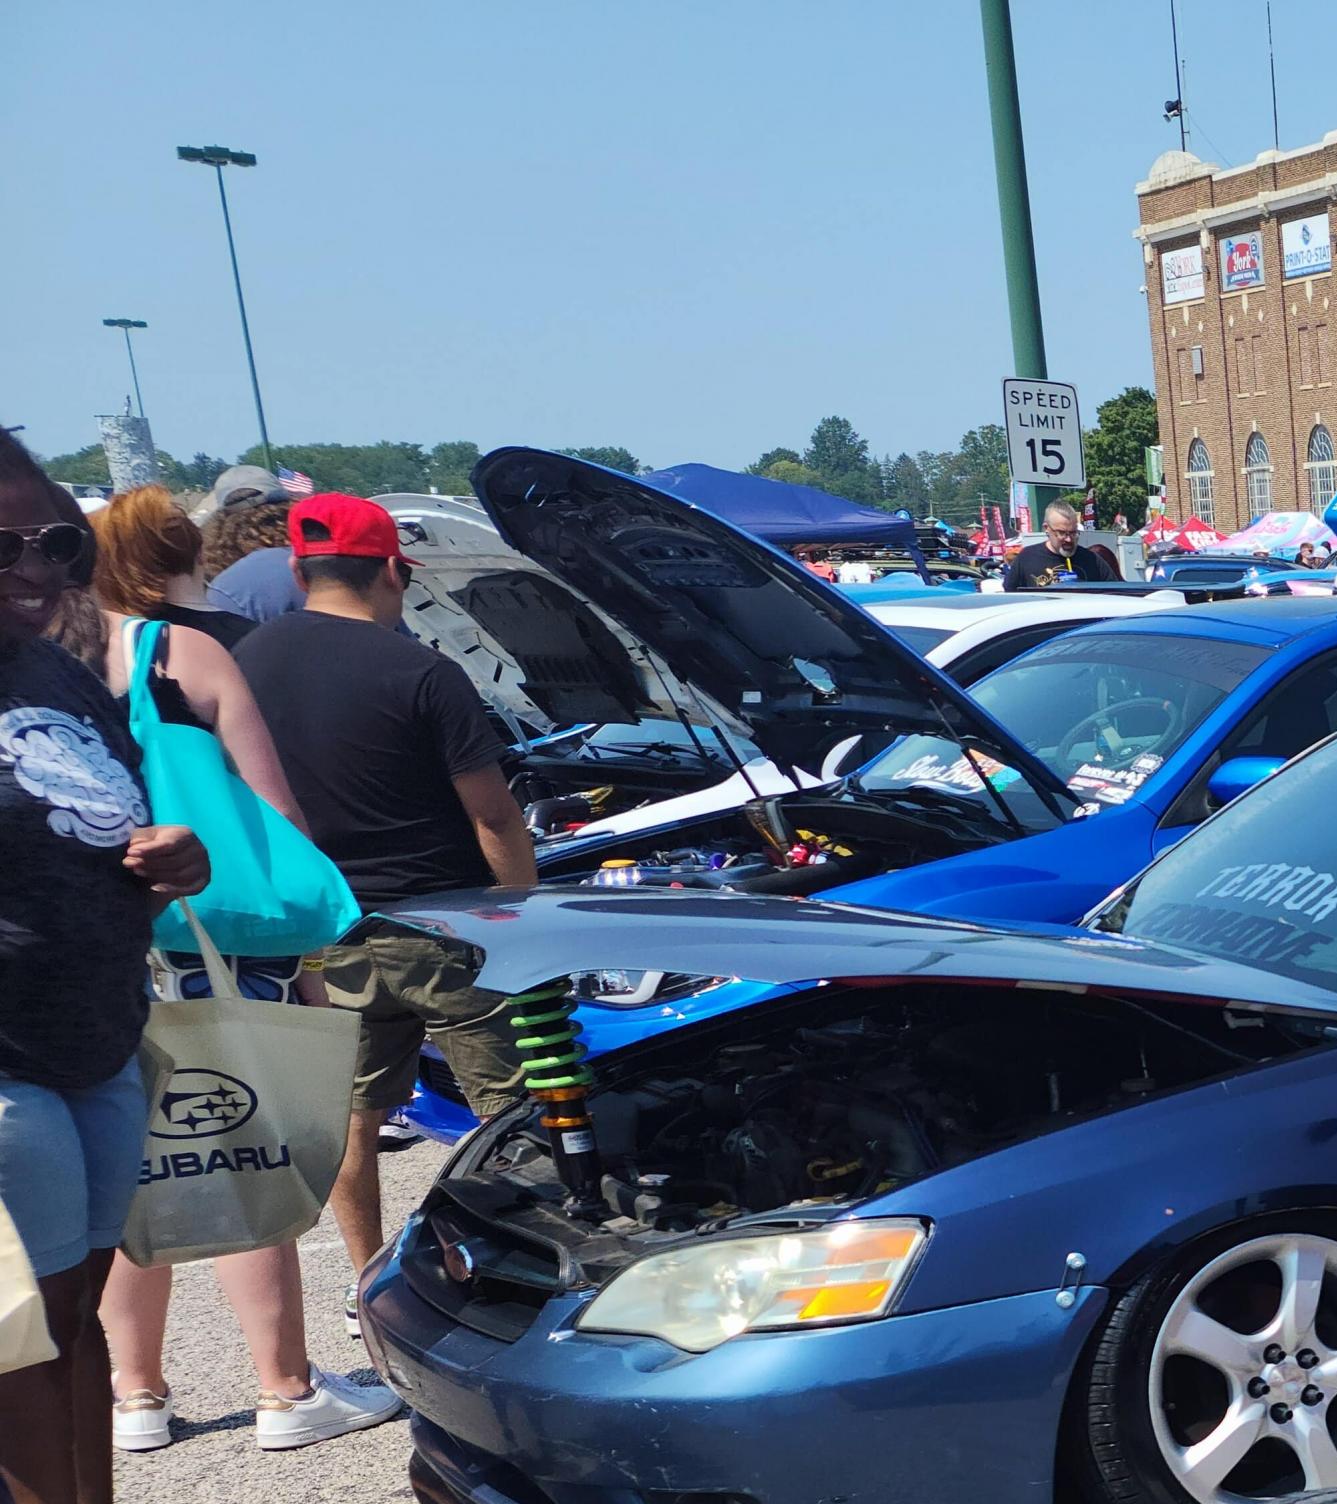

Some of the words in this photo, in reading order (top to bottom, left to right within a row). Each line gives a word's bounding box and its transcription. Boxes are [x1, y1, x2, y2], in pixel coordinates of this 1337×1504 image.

[1285, 246, 1331, 267] PRINT-O-STAT
[1010, 390, 1071, 409] SPEED
[1018, 413, 1066, 430] LIMIT
[1025, 438, 1066, 476] 15
